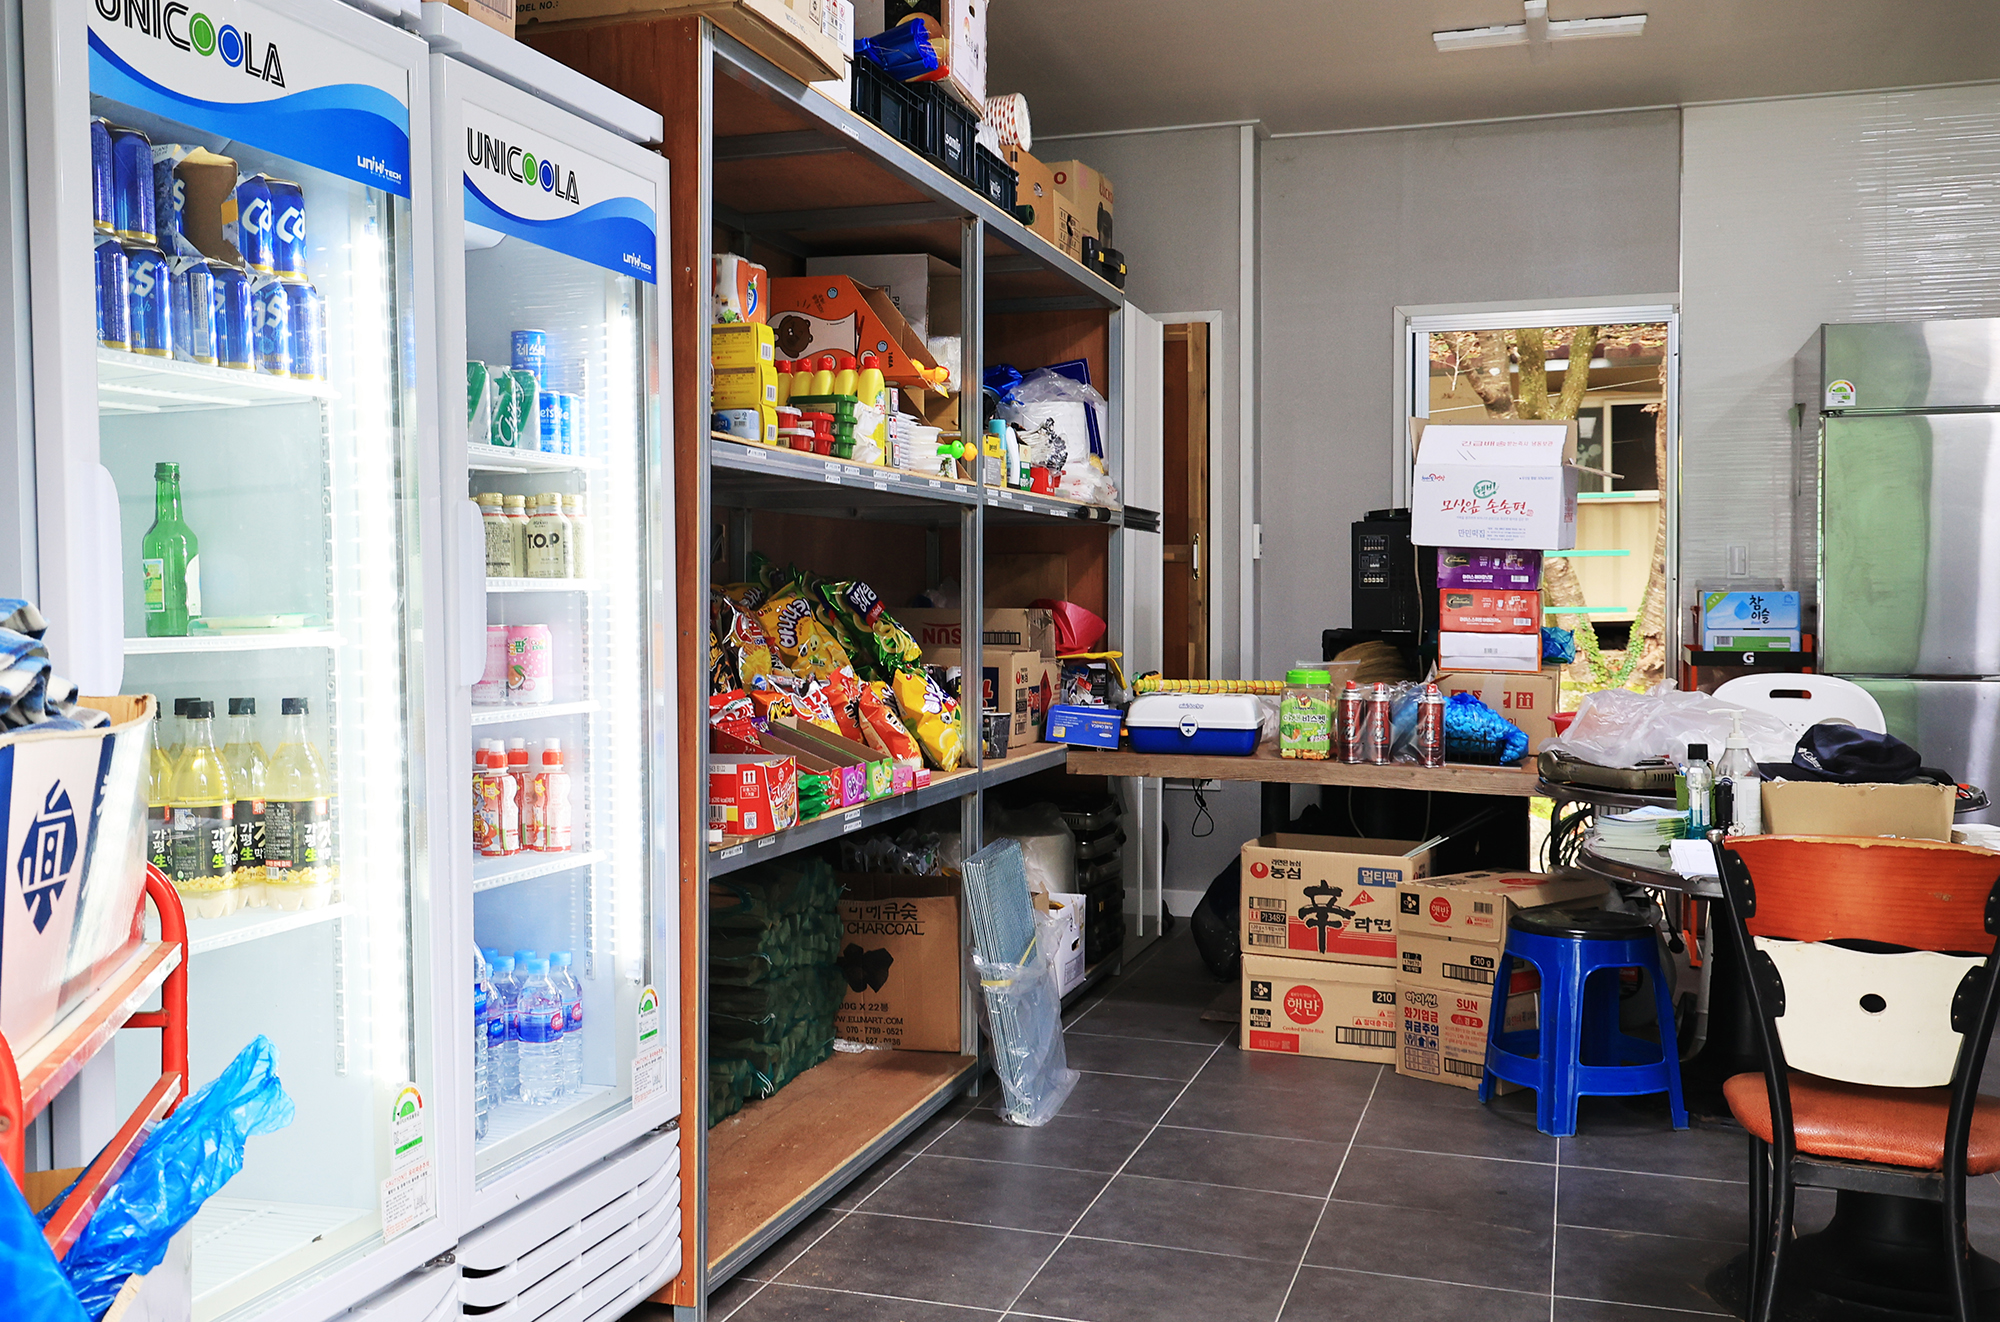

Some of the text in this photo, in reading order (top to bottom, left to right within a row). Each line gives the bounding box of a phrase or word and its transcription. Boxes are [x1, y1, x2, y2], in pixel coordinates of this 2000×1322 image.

[95, 0, 286, 88] UNICOOLA
[467, 126, 580, 205] UNICOOLA
[1749, 594, 1771, 625] 참이슬
[1742, 651, 1755, 664] G
[1270, 865, 1302, 880] 농심
[1361, 870, 1399, 884] 멀티팩
[1359, 893, 1368, 903] 신
[1261, 912, 1286, 923] 가3487
[1298, 879, 1356, 955] 辛
[1431, 904, 1450, 918] 햇반
[846, 922, 925, 936] CHARCOAL
[1354, 917, 1393, 933] 라면
[1376, 993, 1393, 1004] 210
[1456, 998, 1478, 1011] SUN
[838, 1002, 857, 1011] 00G
[1286, 997, 1320, 1017] 햇반
[1404, 1006, 1438, 1024] 화기엄금
[1364, 1019, 1397, 1030] 절대충격금
[1405, 1020, 1439, 1037] 취급주의
